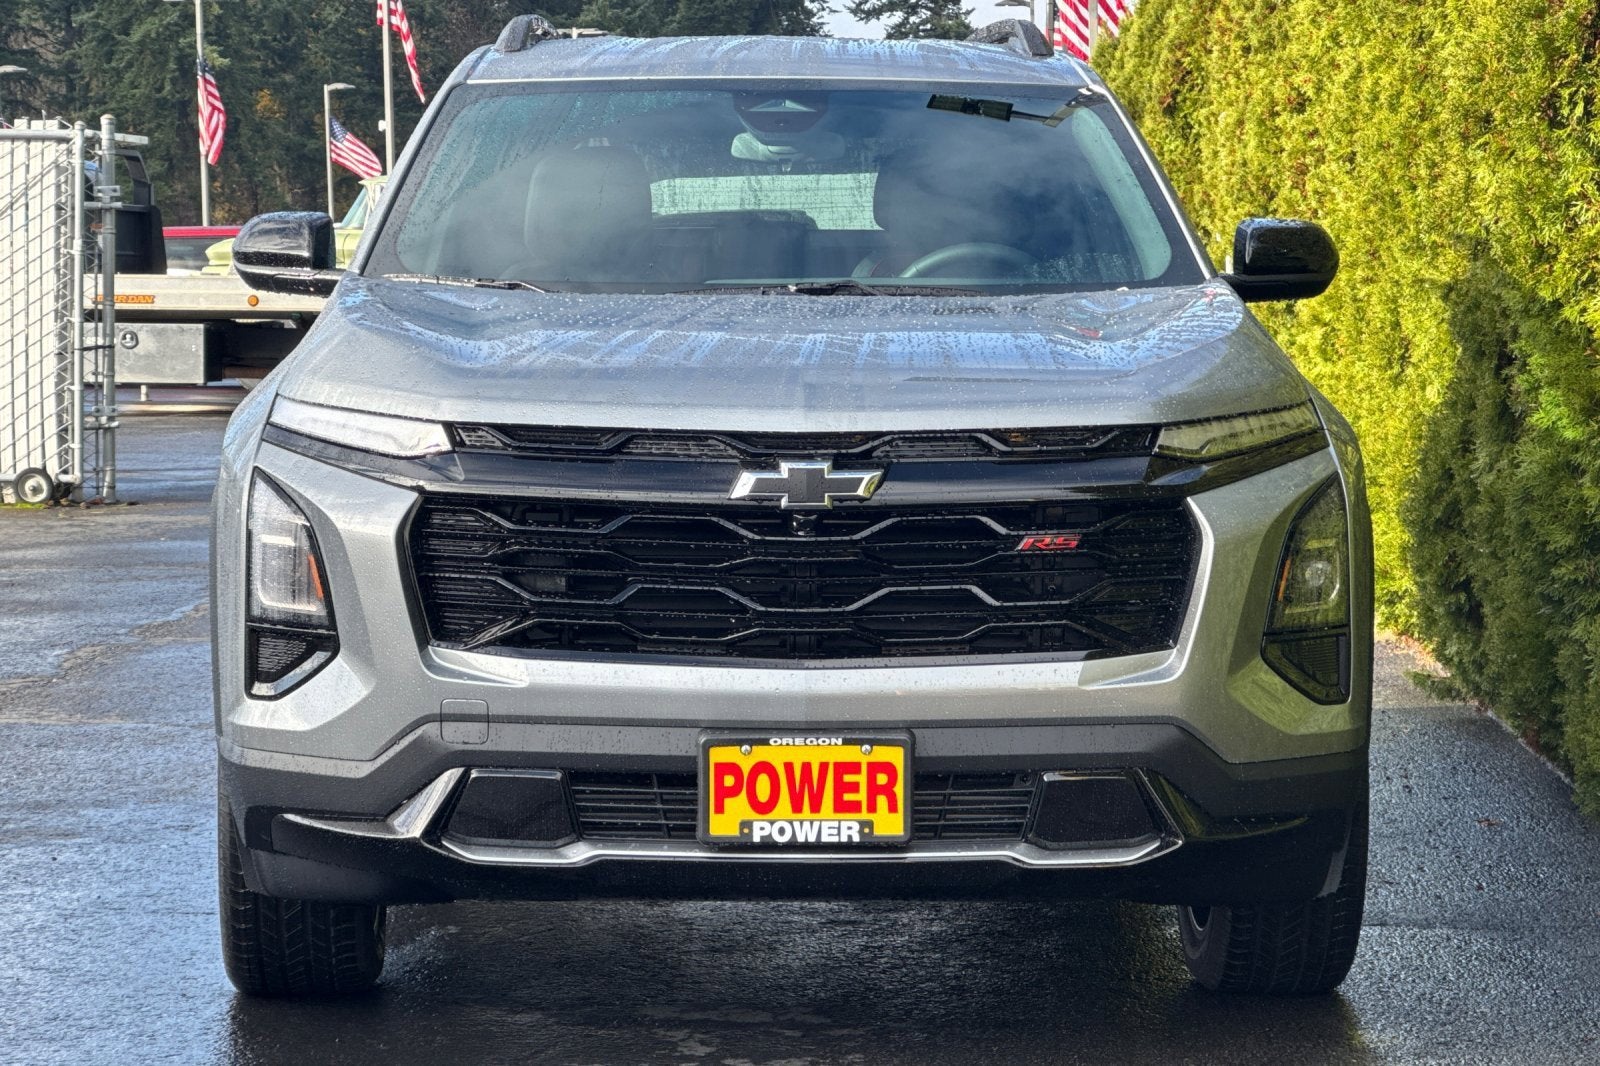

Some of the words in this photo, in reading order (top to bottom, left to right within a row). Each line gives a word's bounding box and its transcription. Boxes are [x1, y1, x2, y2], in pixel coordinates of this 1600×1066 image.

[1015, 534, 1081, 551] RS
[769, 737, 843, 746] OREGON
[713, 760, 899, 815] POWER
[752, 820, 860, 843] POWER
